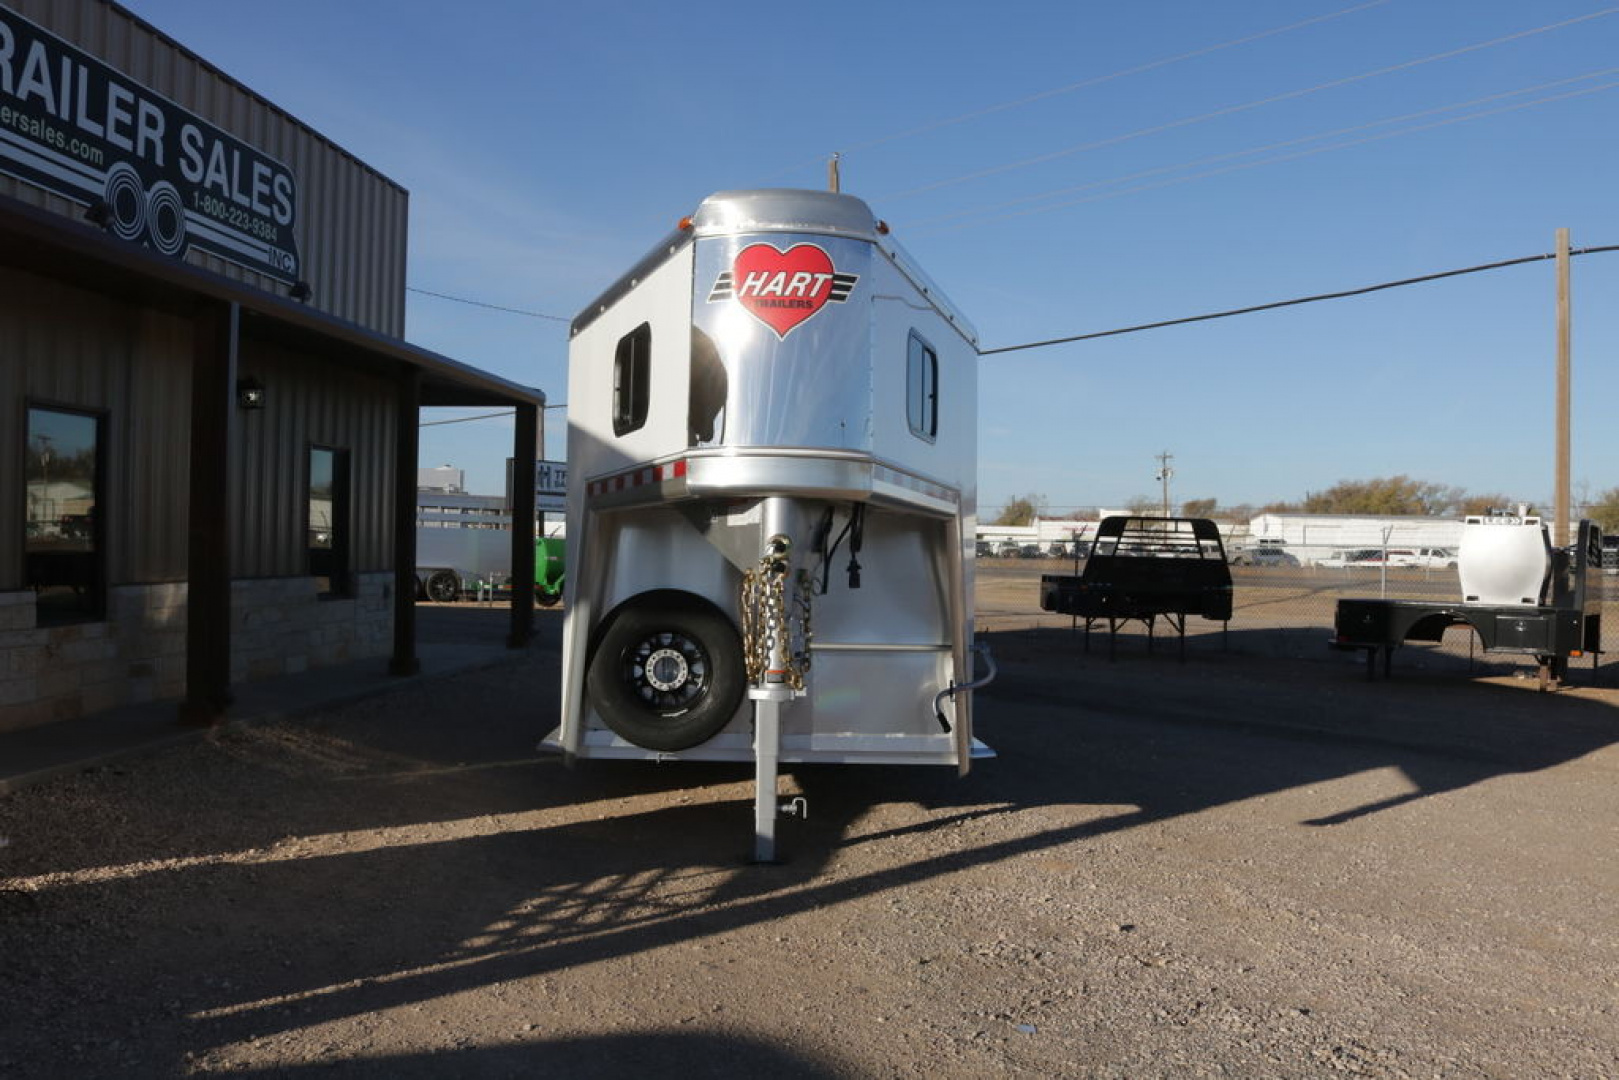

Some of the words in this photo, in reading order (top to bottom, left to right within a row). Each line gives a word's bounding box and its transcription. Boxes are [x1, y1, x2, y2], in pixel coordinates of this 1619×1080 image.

[179, 123, 293, 226] SALES
[192, 190, 278, 242] 1-800-223-9384
[268, 247, 294, 273] INC
[739, 271, 833, 297] HART
[755, 299, 813, 309] TRAILERS
